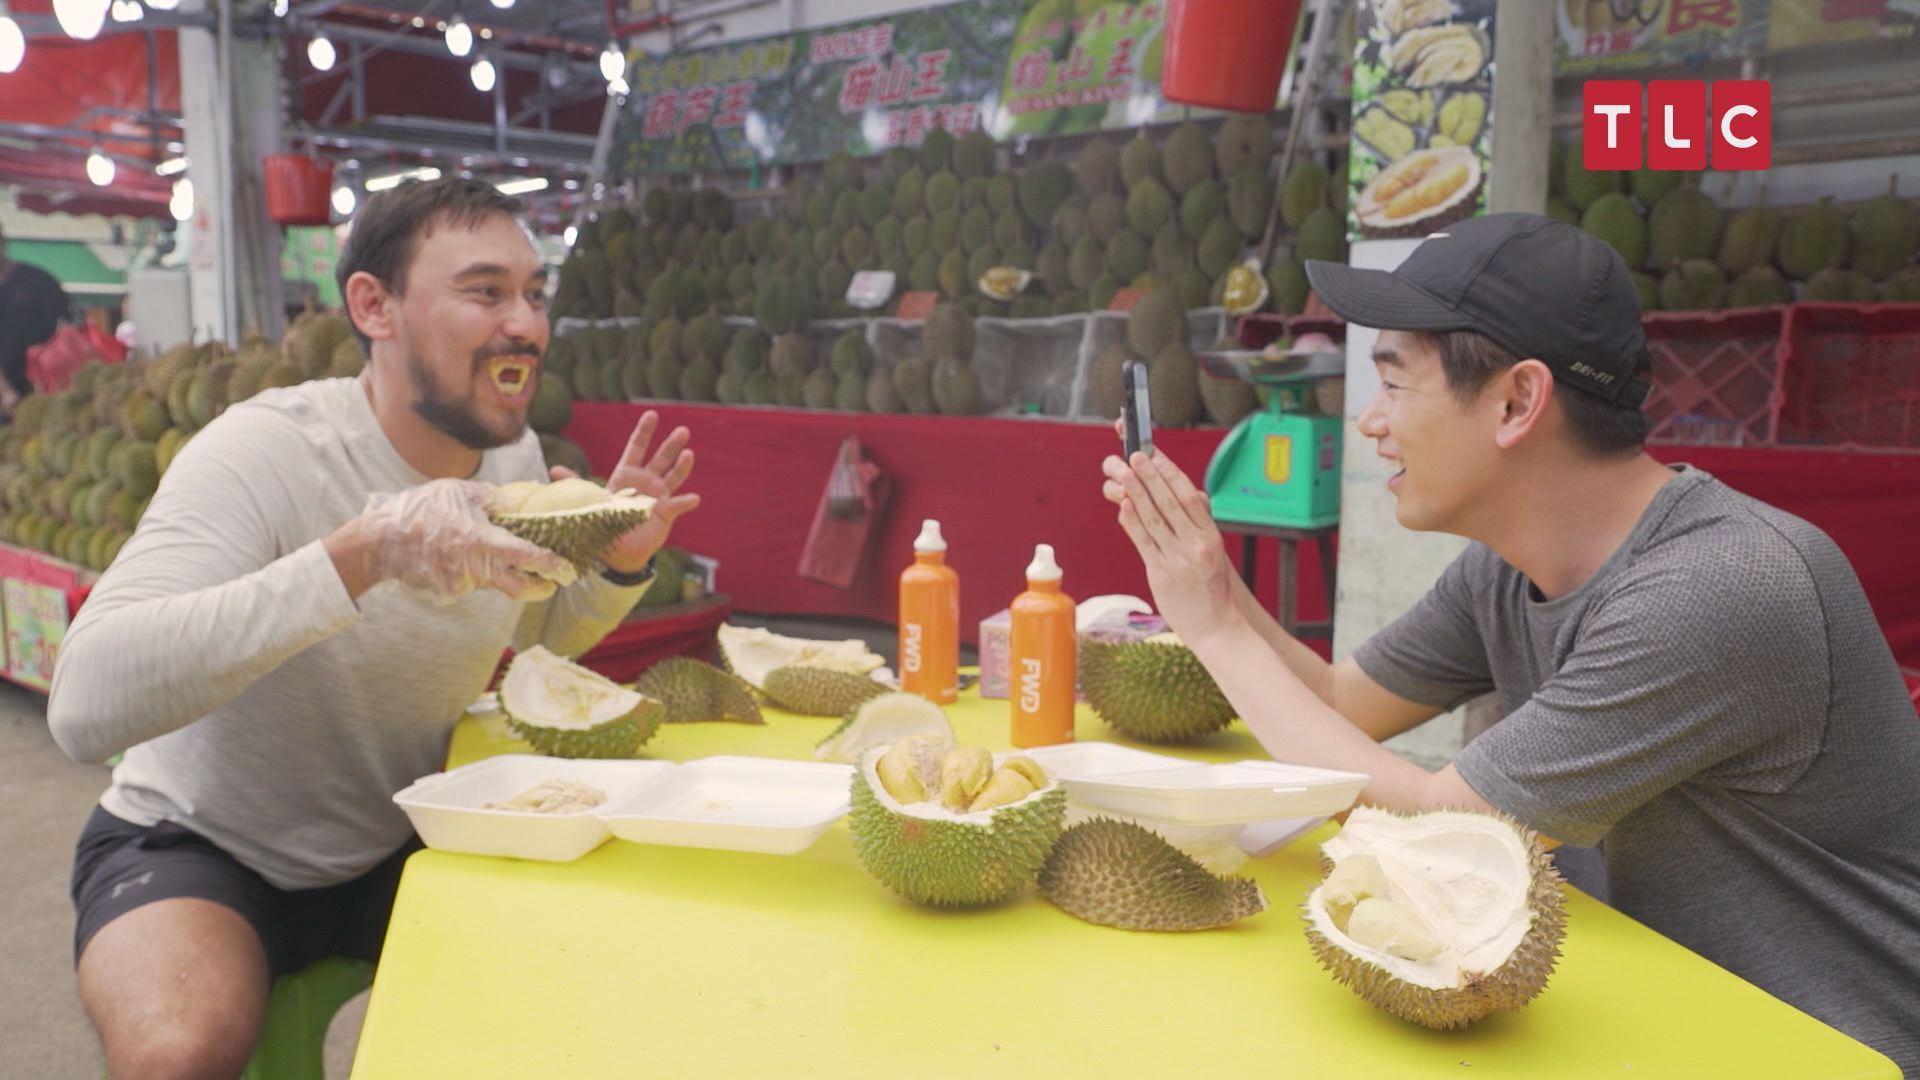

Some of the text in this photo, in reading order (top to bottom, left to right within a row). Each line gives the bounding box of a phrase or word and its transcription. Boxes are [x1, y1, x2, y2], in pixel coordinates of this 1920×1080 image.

[838, 48, 952, 114] 猫山王
[1013, 38, 1137, 90] 猫山王
[1570, 361, 1615, 385] DRI-FIT
[903, 623, 923, 673] FWD
[1020, 658, 1042, 714] FWD
